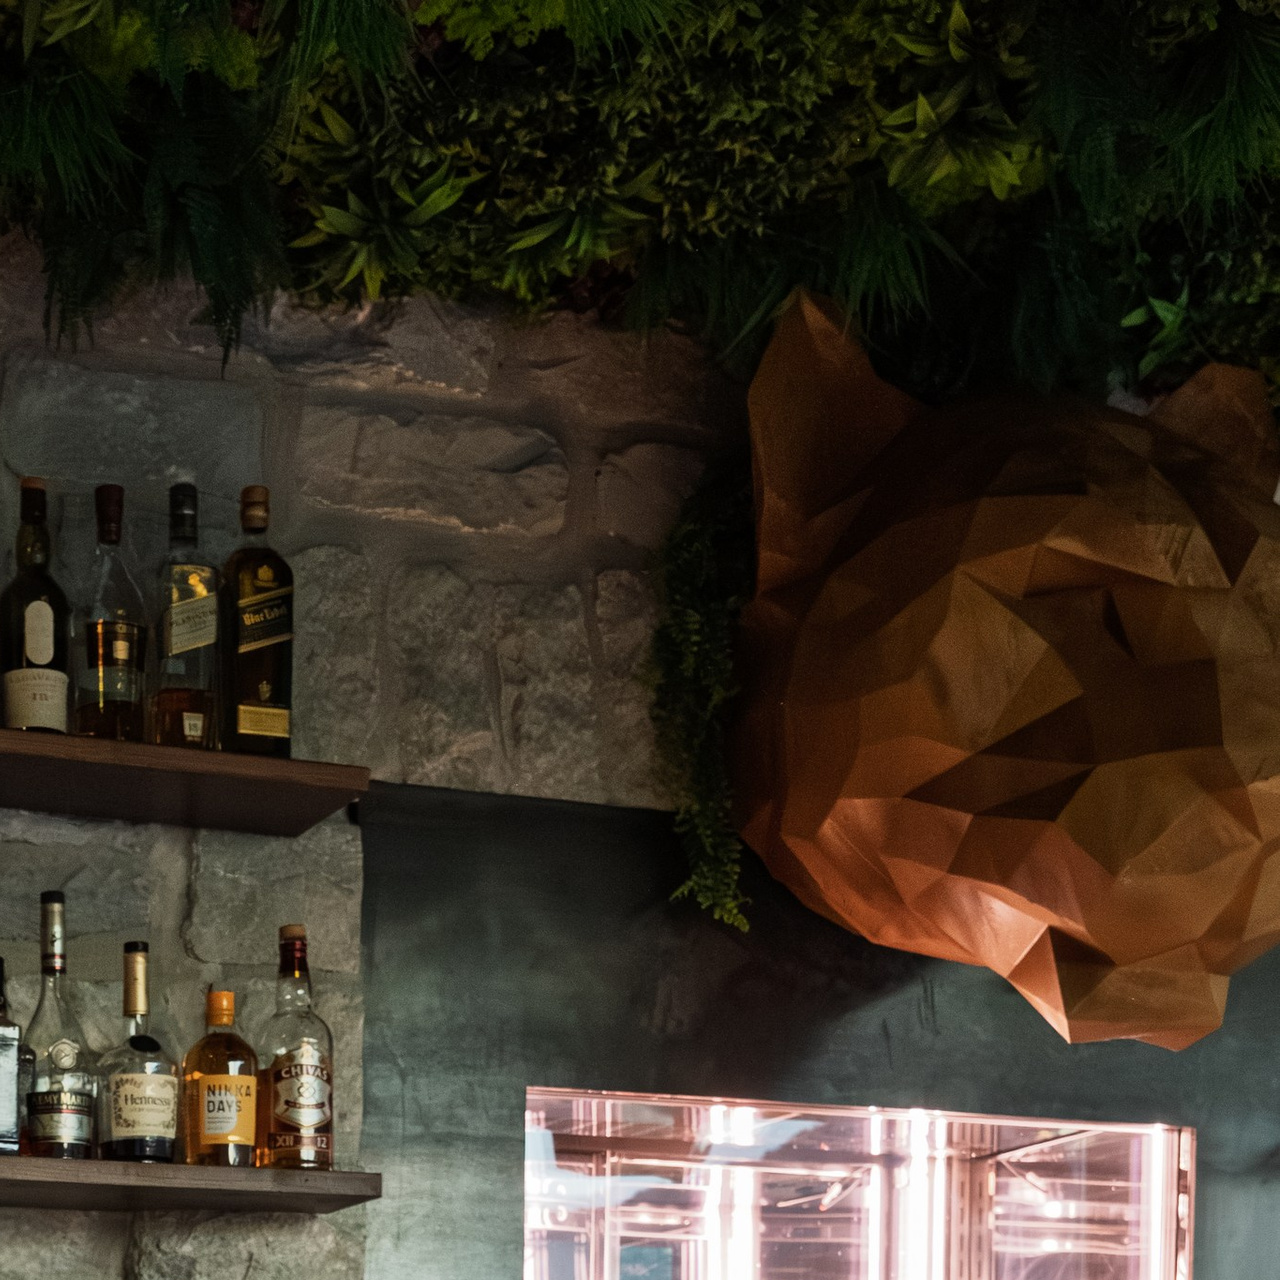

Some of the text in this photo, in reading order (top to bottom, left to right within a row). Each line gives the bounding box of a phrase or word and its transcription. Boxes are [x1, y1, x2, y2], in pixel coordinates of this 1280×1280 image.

[281, 1064, 328, 1081] CHIVAS
[207, 1083, 252, 1098] NIKKA
[207, 1100, 242, 1114] DAYS
[316, 1136, 328, 1149] 12
